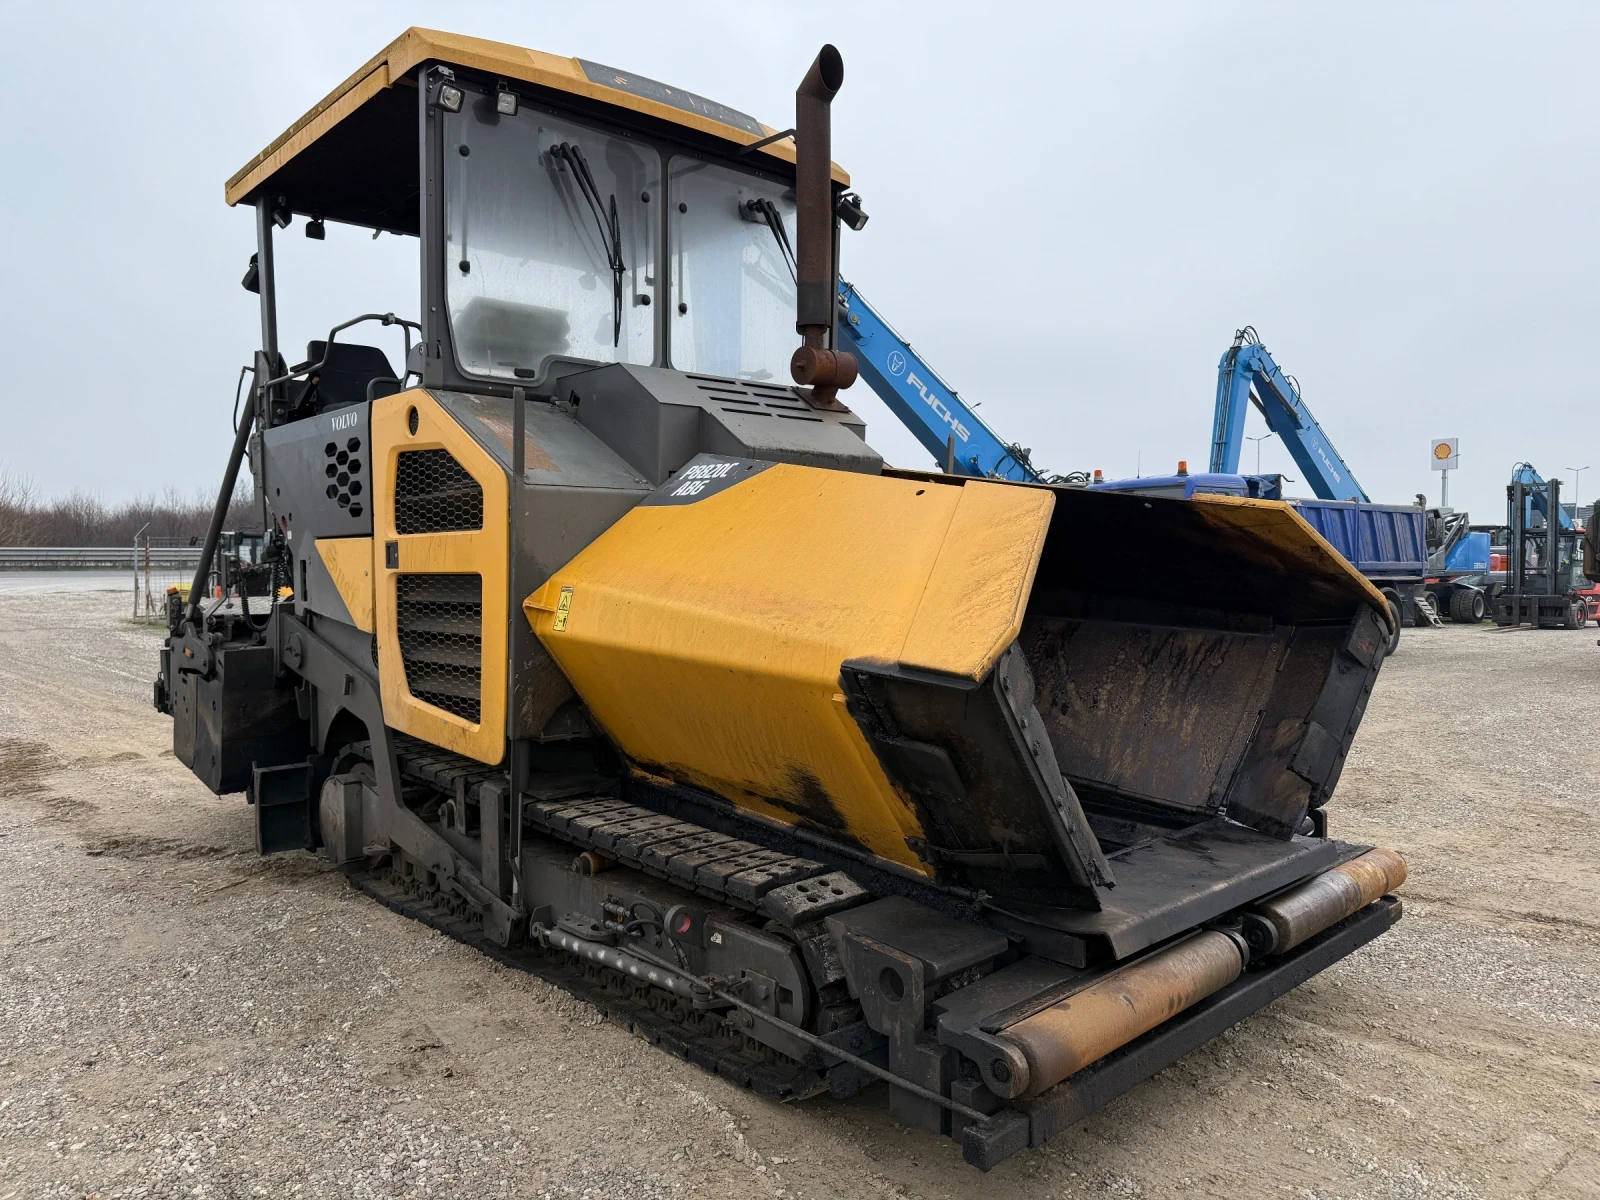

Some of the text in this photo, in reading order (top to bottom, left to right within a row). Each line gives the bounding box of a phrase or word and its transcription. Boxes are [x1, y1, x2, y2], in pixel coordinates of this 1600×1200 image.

[331, 411, 358, 431] VOLVO
[906, 371, 971, 443] FUCHS
[1318, 447, 1340, 484] FUCHS
[670, 479, 710, 497] ABG
